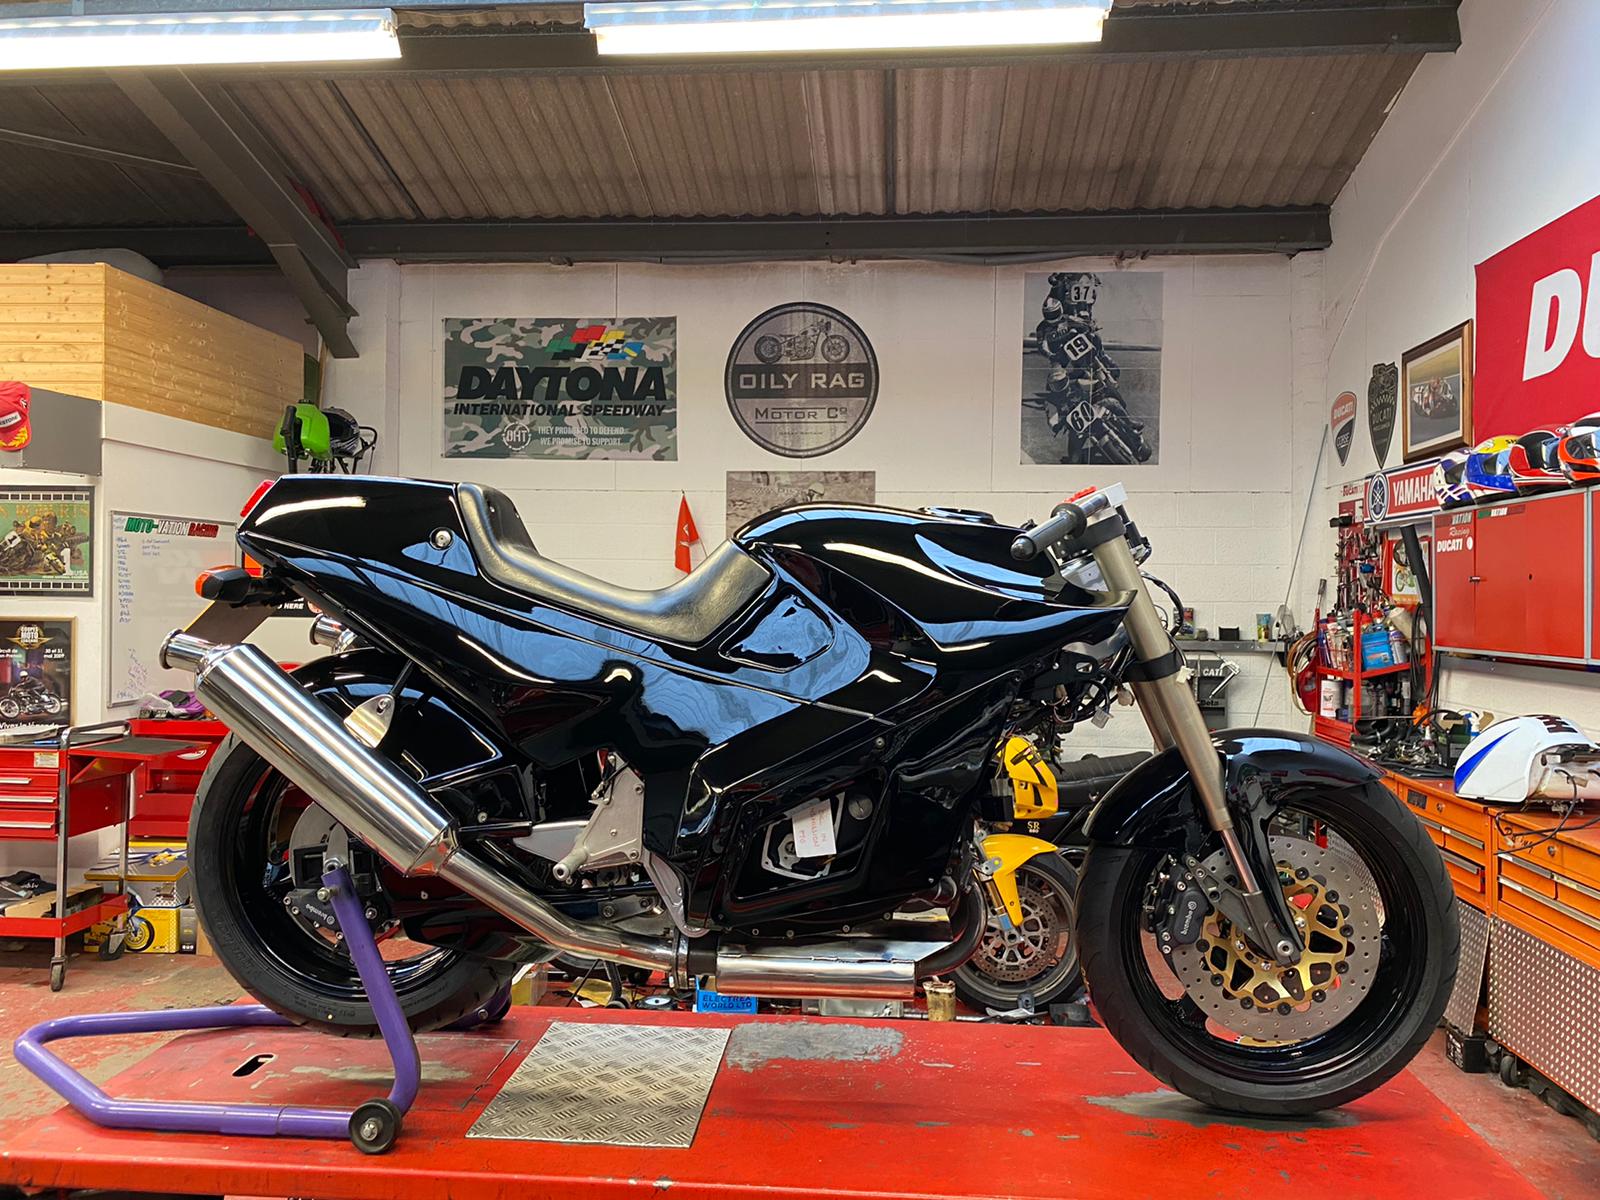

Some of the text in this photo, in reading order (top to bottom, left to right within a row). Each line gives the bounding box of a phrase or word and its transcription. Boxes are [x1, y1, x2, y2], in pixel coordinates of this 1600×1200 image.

[1073, 286, 1090, 300] 37
[1066, 335, 1089, 357] 19
[456, 366, 668, 401] DAYTONA
[739, 373, 865, 389] OILY RAG
[453, 403, 666, 417] INTERNATIONAL SPEEDWAY
[1070, 402, 1095, 432] 60
[1333, 401, 1354, 419] DUCATI
[538, 426, 554, 435] THEY
[589, 426, 598, 435] TO
[552, 437, 582, 446] PROMISE
[1393, 474, 1436, 506] YAMAHA
[1436, 538, 1463, 553] DUCATI
[1027, 821, 1041, 830] SR
[1180, 910, 1193, 934] brembo
